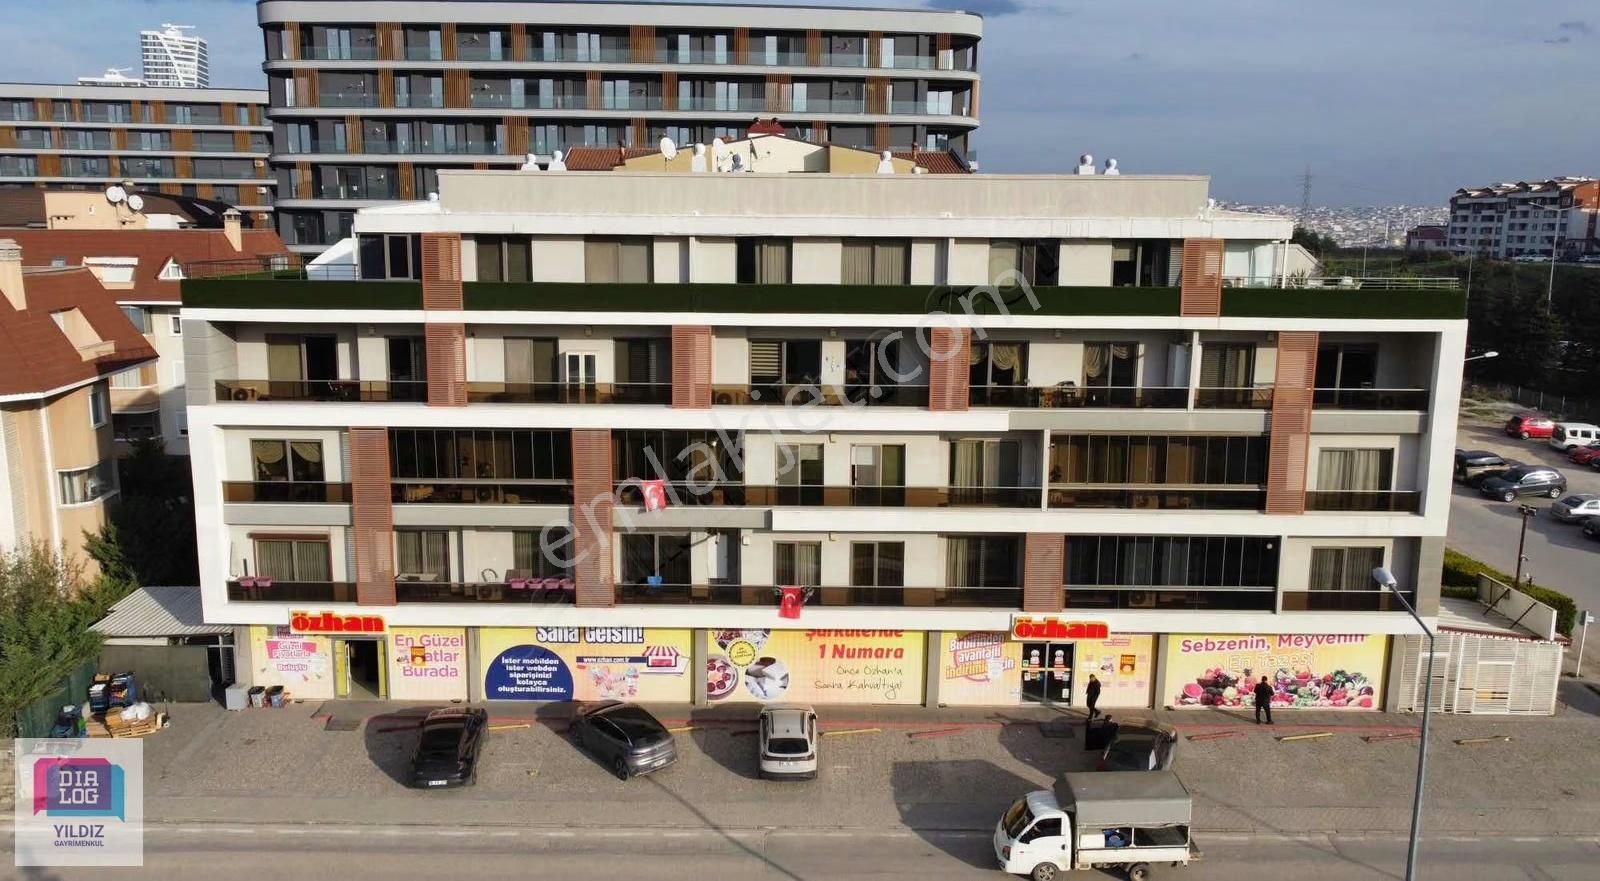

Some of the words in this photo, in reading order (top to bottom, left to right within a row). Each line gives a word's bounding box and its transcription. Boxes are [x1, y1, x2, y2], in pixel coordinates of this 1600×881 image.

[291, 612, 385, 632] özhan
[1014, 617, 1109, 639] özhan
[395, 634, 415, 647] En
[419, 634, 464, 647] Güzel
[1181, 635, 1270, 653] Sebzenin,
[819, 644, 826, 659] 1
[832, 644, 904, 659] Numara
[522, 656, 559, 665] mobilden
[403, 665, 459, 677] Burada
[526, 664, 558, 672] webden
[509, 671, 552, 680] siparişinizi
[516, 678, 547, 687] kolayca
